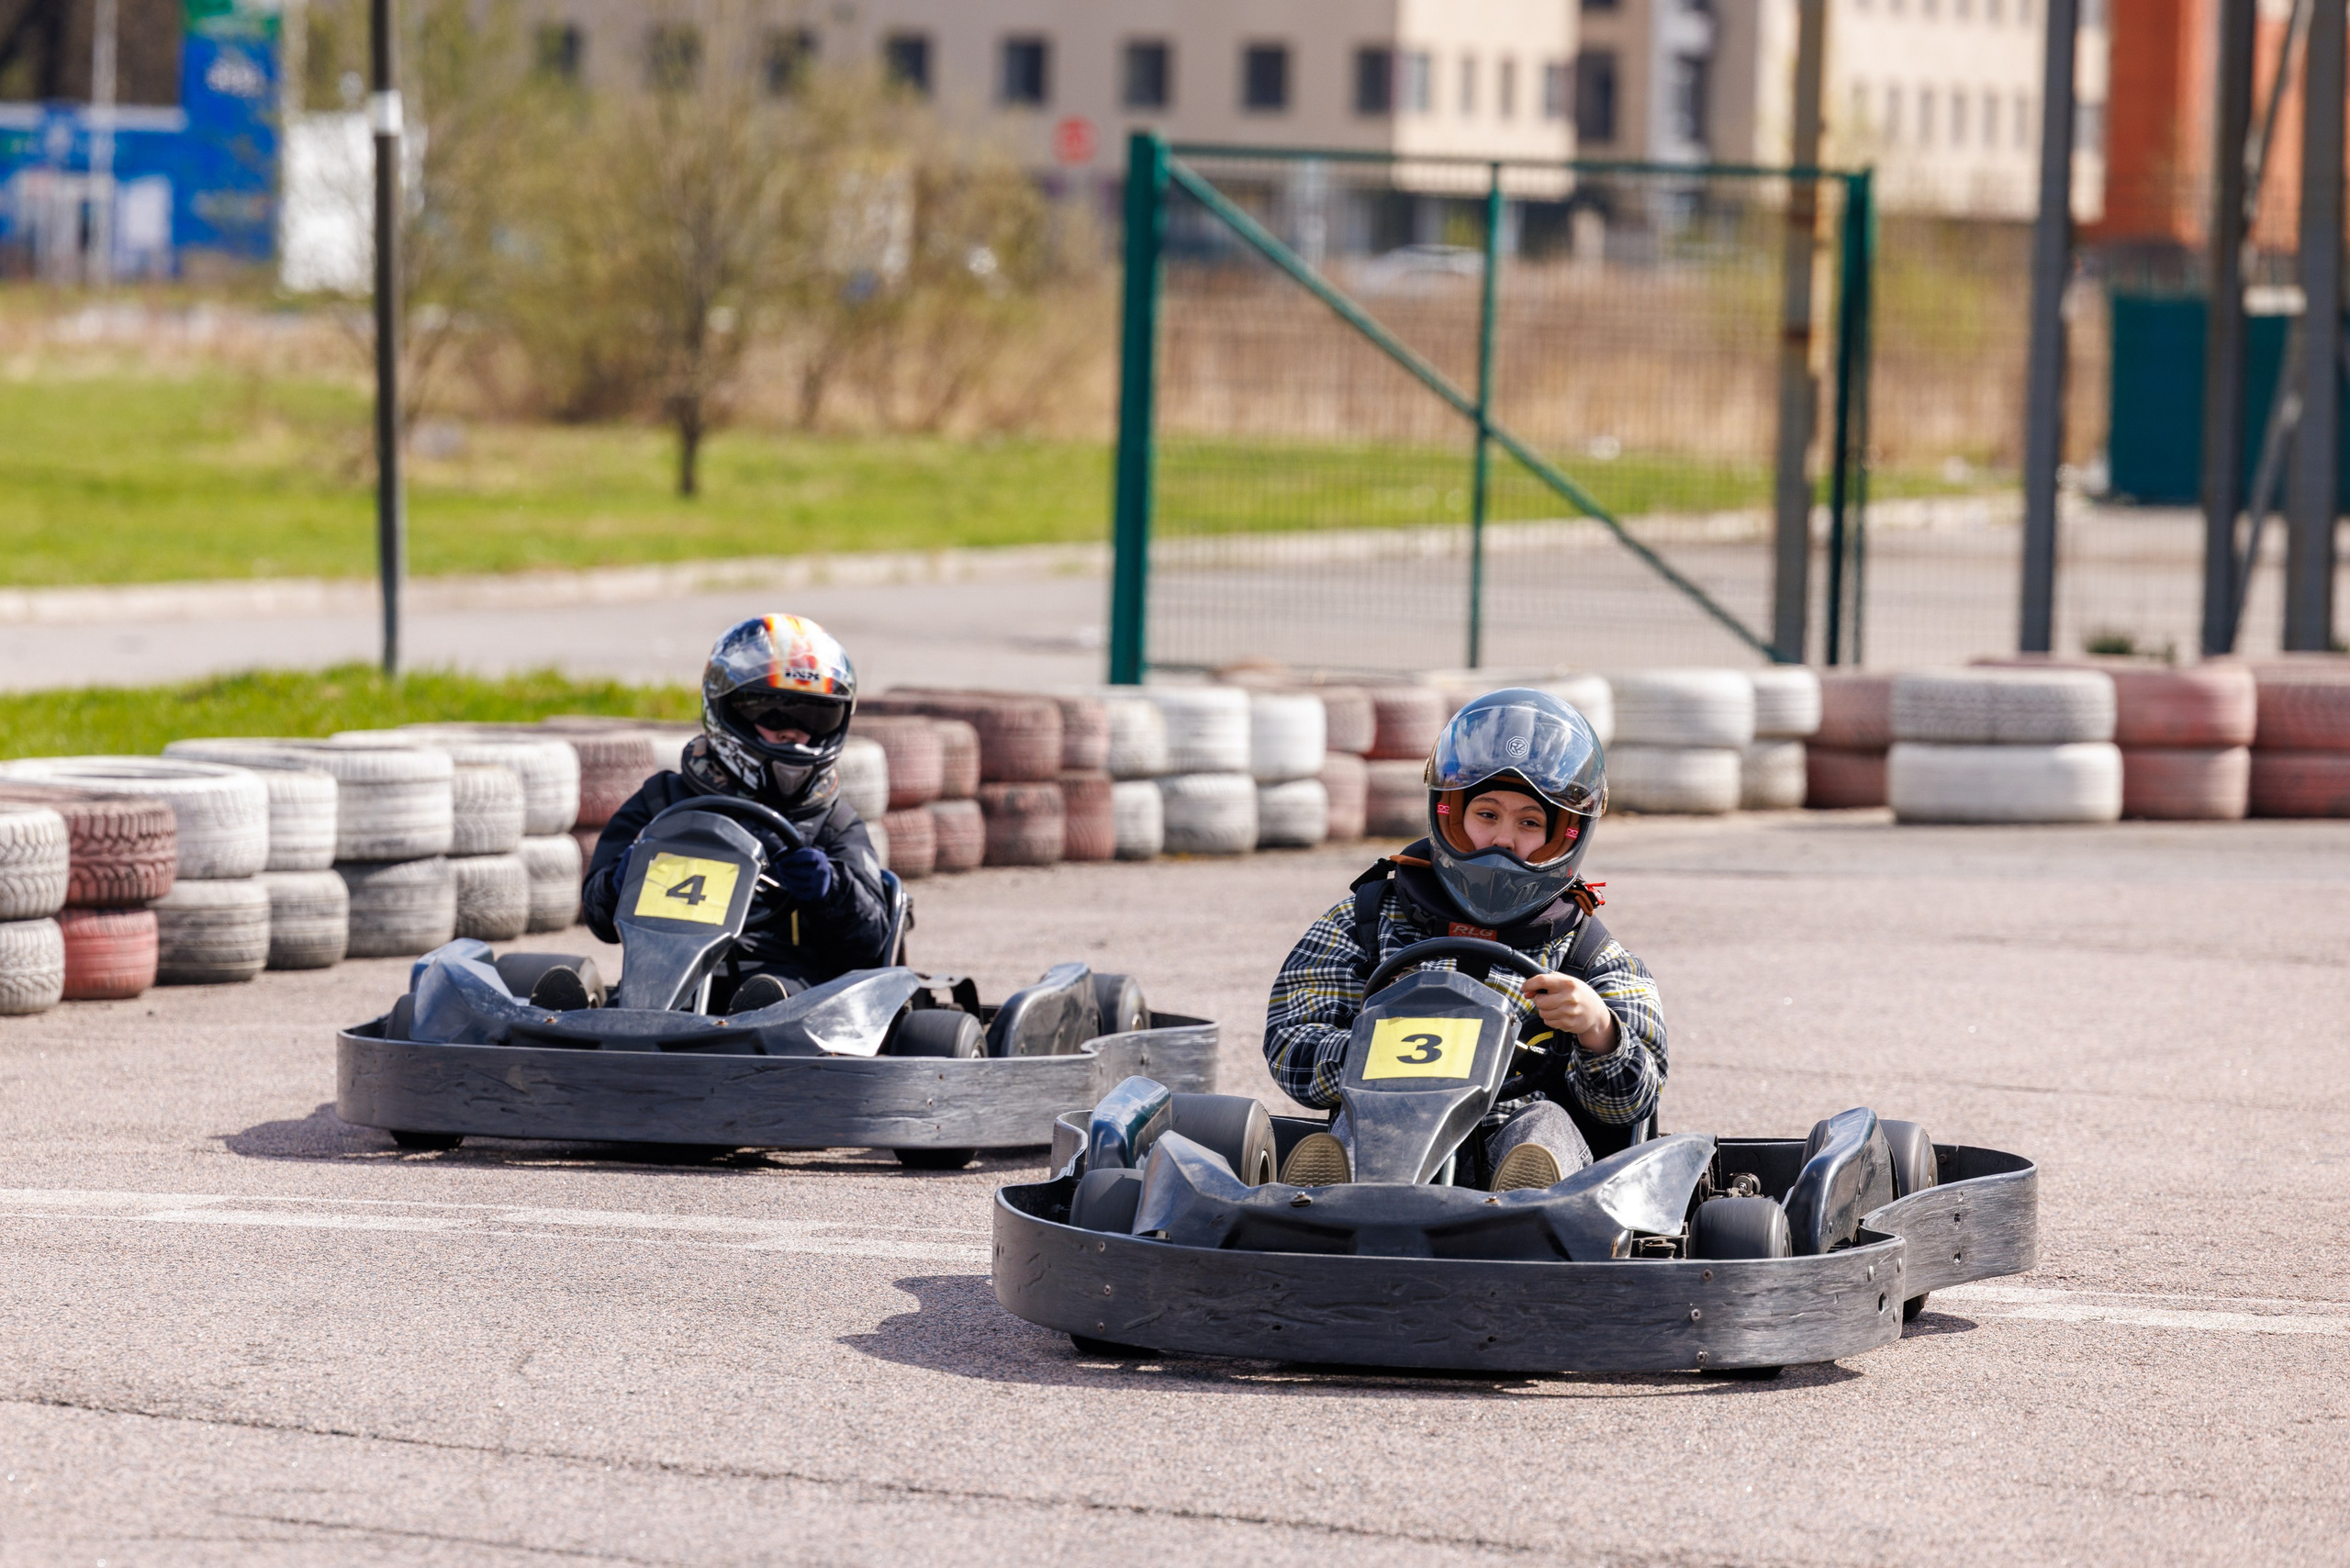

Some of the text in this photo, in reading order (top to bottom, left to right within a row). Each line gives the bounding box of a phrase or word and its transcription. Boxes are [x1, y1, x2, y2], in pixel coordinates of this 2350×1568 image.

[666, 874, 707, 906] 4
[1452, 924, 1494, 936] RLG
[1396, 1033, 1443, 1065] 3
